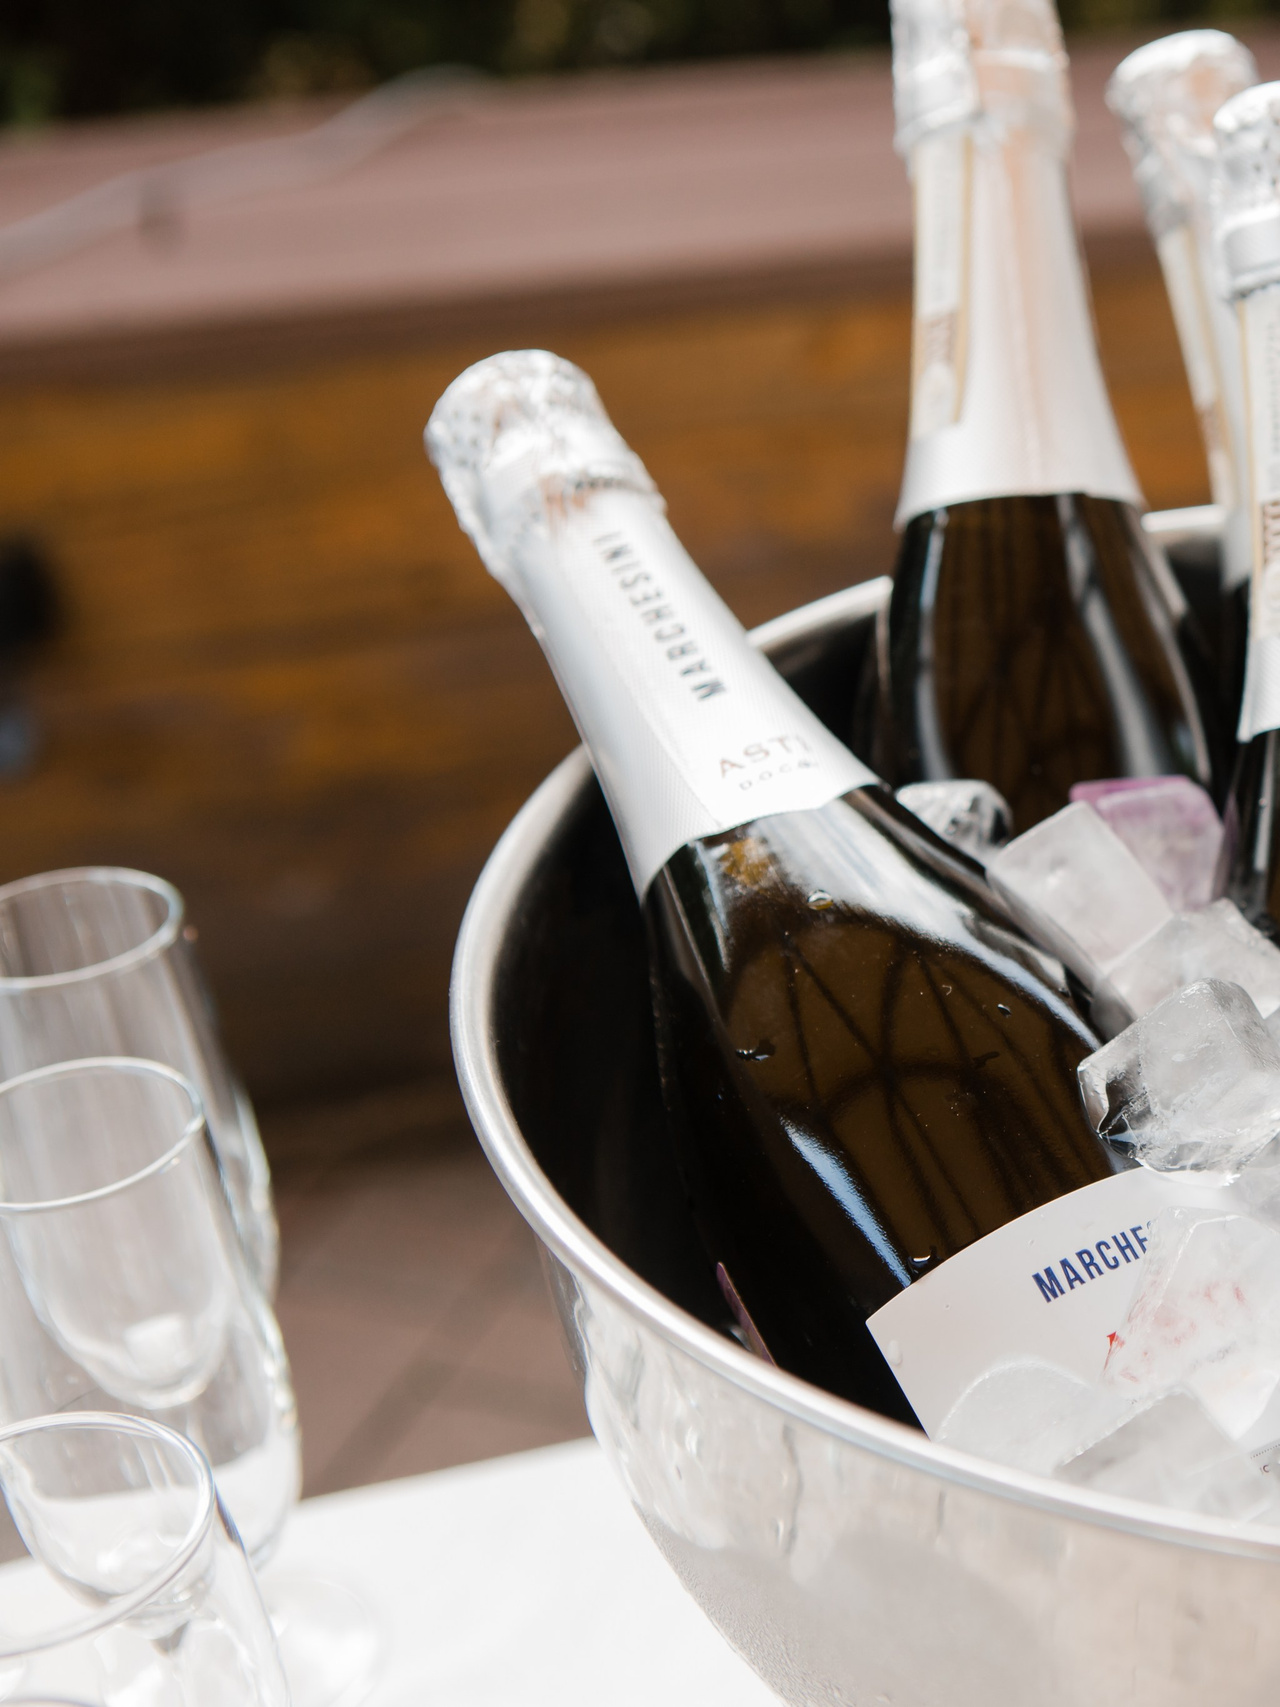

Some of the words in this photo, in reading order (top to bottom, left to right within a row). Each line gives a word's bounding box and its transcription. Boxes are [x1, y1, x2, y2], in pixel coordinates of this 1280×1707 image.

[594, 531, 726, 701] MARCHESINI
[718, 734, 812, 779] ASTI
[1032, 1220, 1153, 1304] MARCHE
